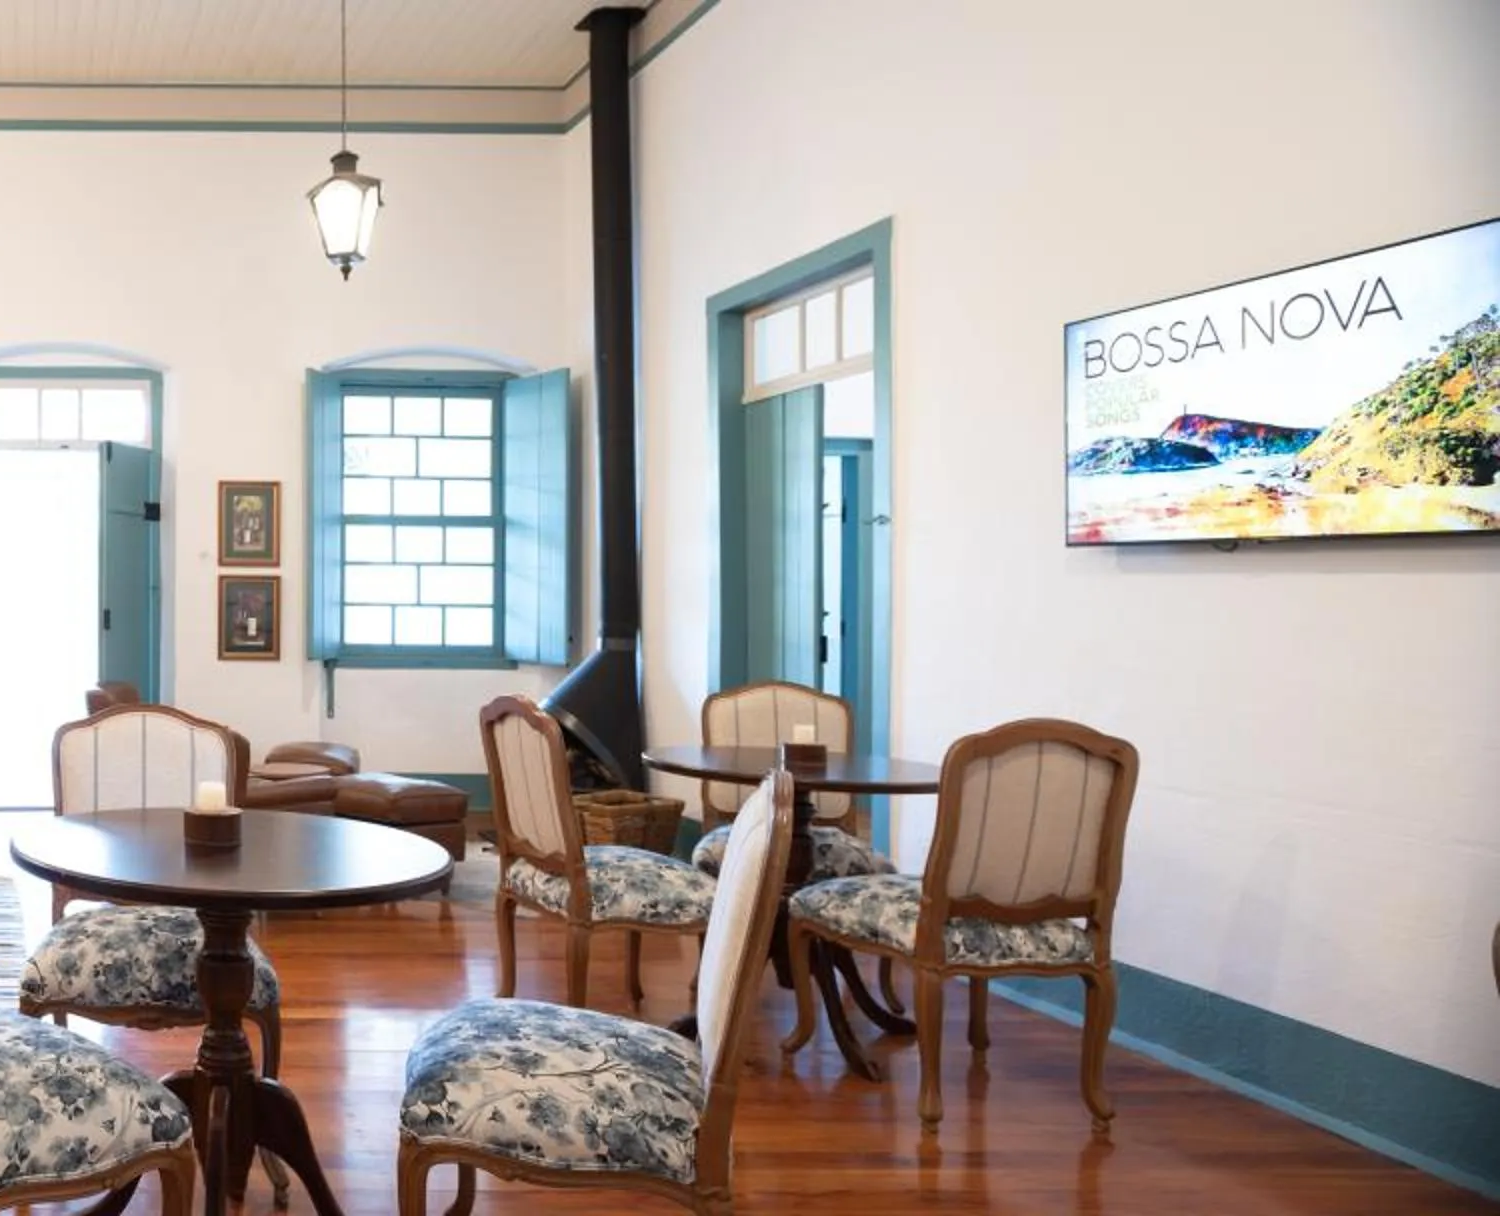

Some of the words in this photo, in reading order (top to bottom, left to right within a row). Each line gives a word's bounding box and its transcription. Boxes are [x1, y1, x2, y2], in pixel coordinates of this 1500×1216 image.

[1084, 315, 1225, 379] BOSSA
[1241, 276, 1403, 350] NOVA
[1085, 407, 1141, 429] SONGS
